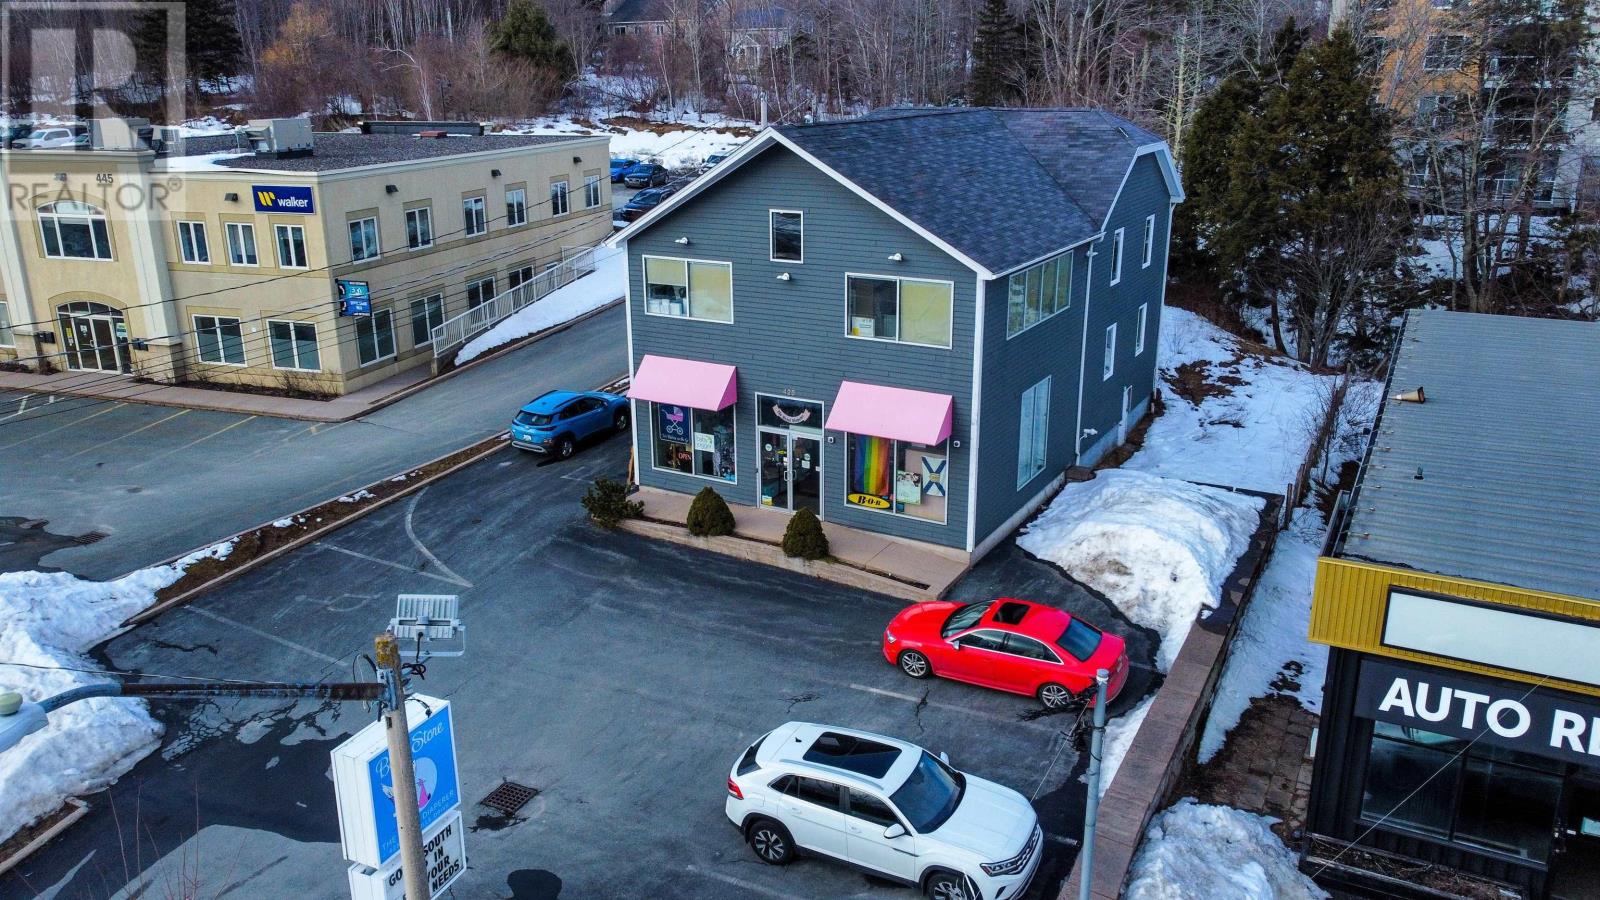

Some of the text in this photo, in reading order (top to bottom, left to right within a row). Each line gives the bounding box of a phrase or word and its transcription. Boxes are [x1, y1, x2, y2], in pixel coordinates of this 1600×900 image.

[96, 173, 114, 184] 445
[277, 195, 309, 209] walker
[1378, 676, 1532, 738] AUTO
[411, 722, 444, 753] Store
[423, 824, 452, 857] SOUTH
[434, 846, 444, 862] IN
[432, 859, 460, 892] NEEDS
